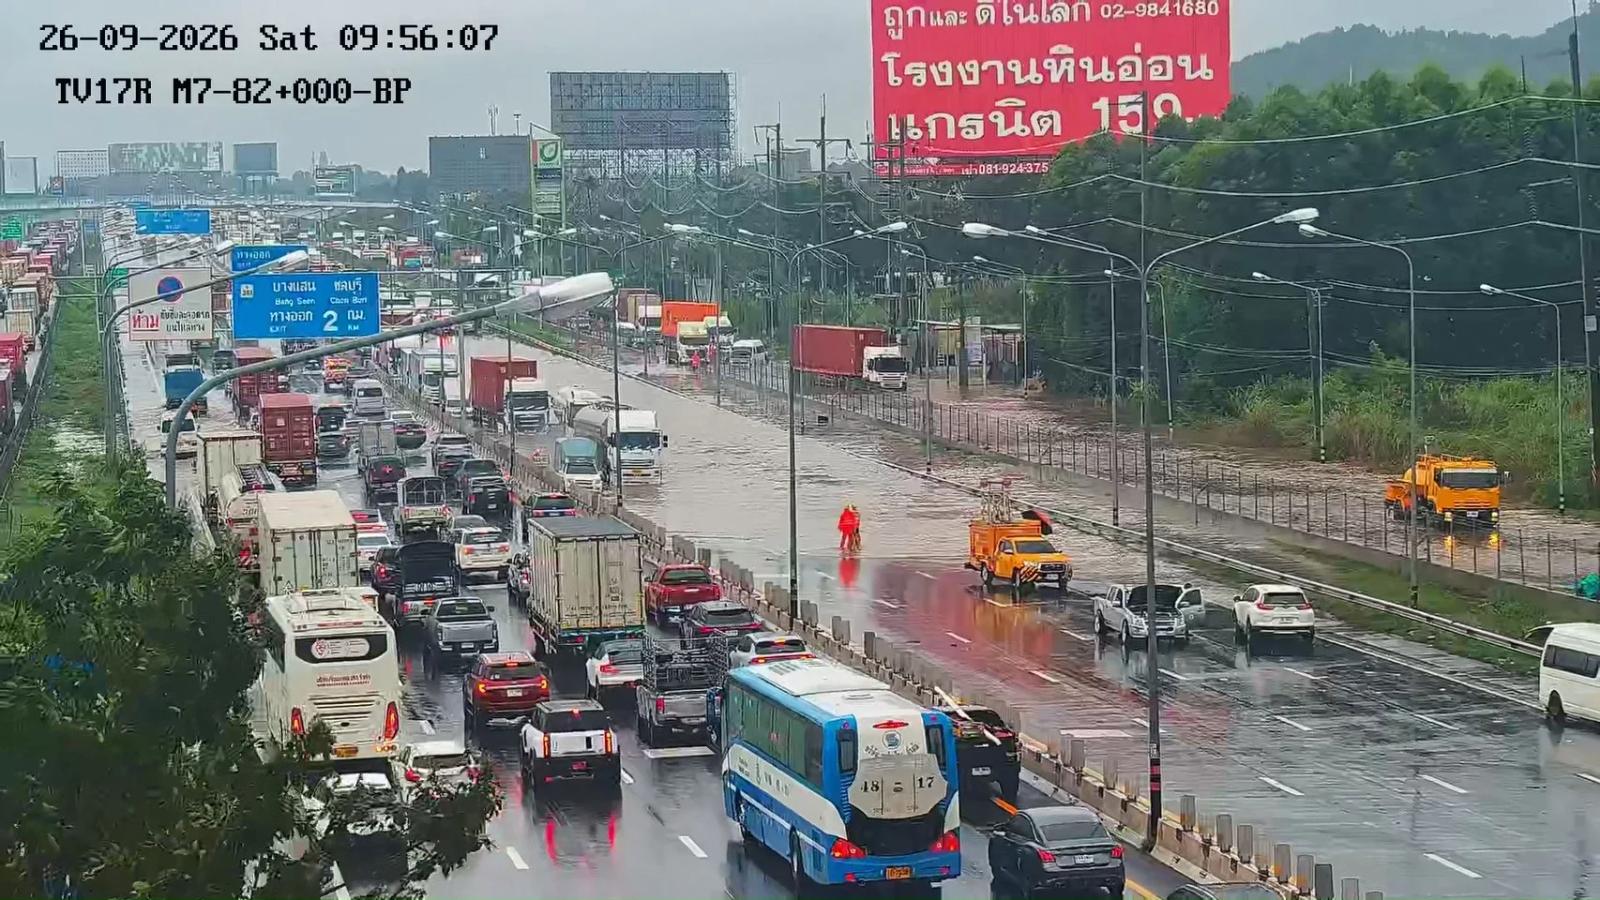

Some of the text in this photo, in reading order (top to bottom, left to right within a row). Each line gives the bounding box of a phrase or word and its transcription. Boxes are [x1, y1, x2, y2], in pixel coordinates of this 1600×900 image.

[1100, 1, 1220, 19] 02-9841680
[880, 43, 1214, 88] โรงงานหินอ่อน
[888, 97, 1062, 140] แกรนิต
[272, 277, 362, 295] บางแสน ชลบุรี
[131, 308, 160, 329] ห้าม
[269, 310, 313, 323] ทางออก
[322, 309, 339, 332] 2
[917, 776, 935, 789] 17
